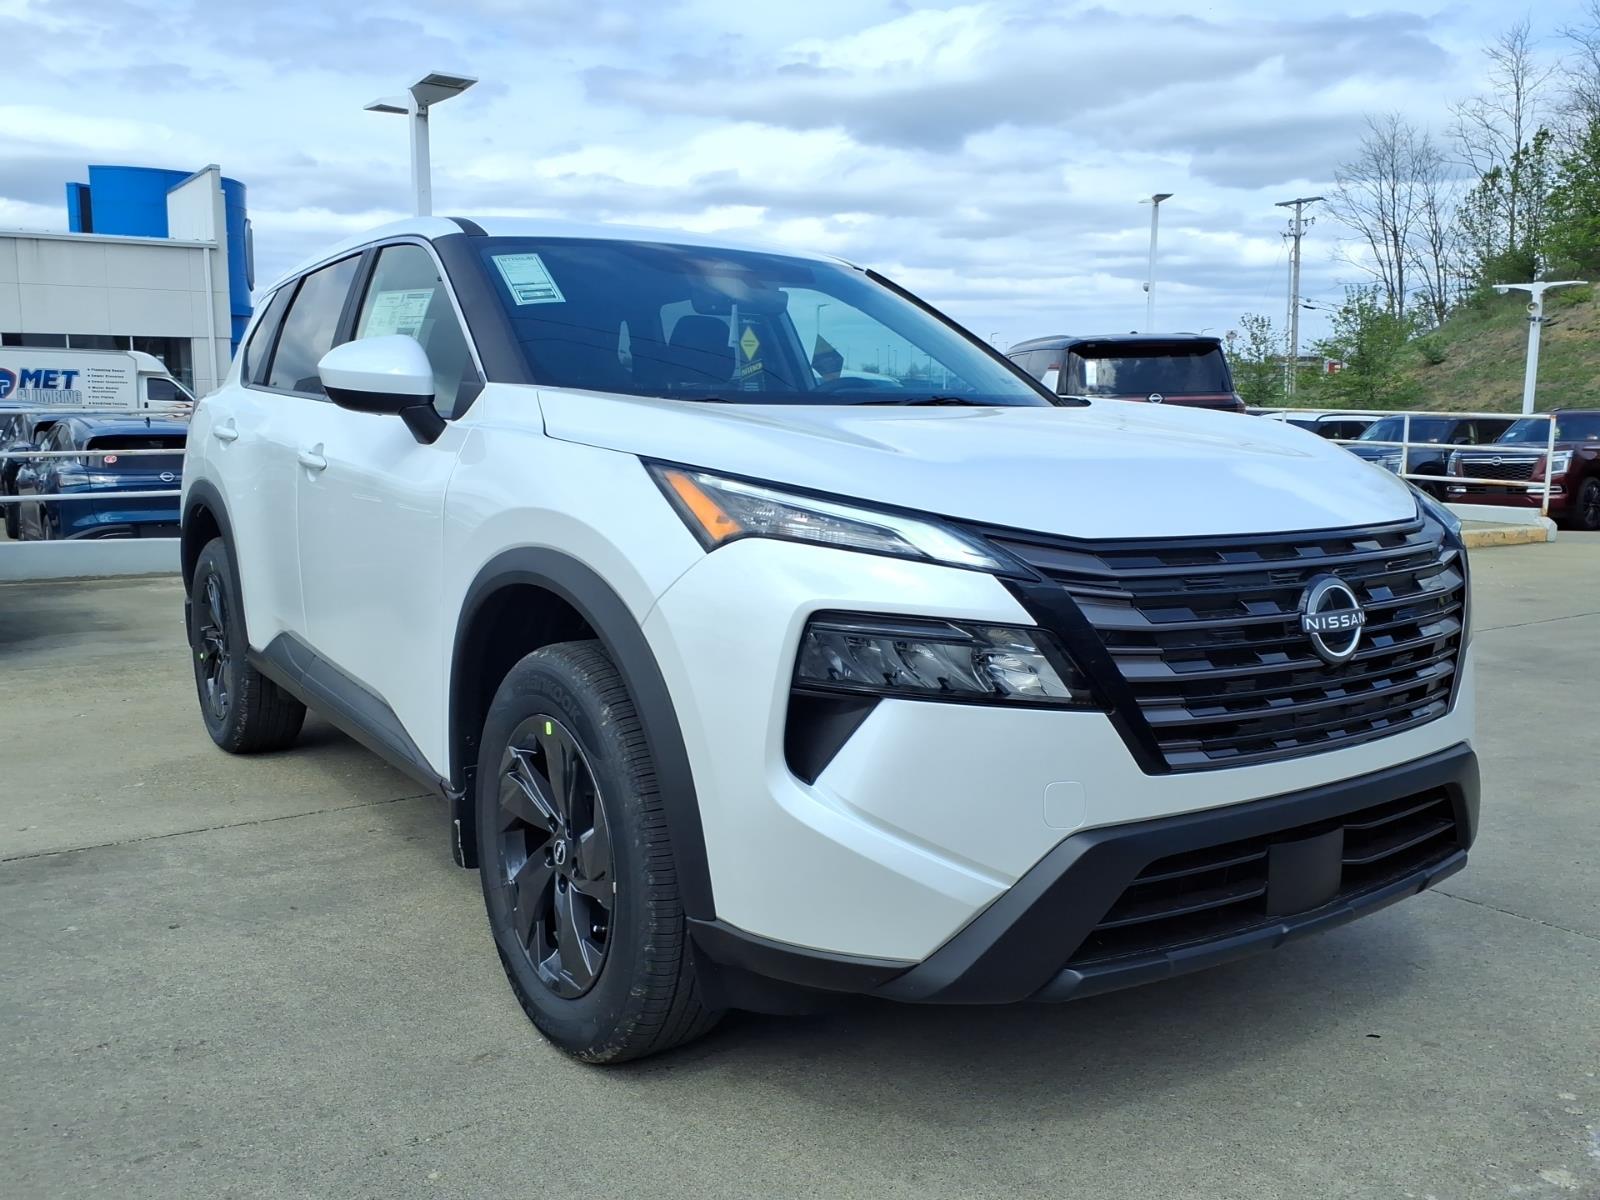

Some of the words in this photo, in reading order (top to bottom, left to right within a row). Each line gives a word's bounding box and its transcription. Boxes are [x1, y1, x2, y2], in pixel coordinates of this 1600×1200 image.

[19, 368, 80, 390] MET
[17, 388, 82, 404] PLUMBING
[1305, 610, 1366, 630] NISSAN
